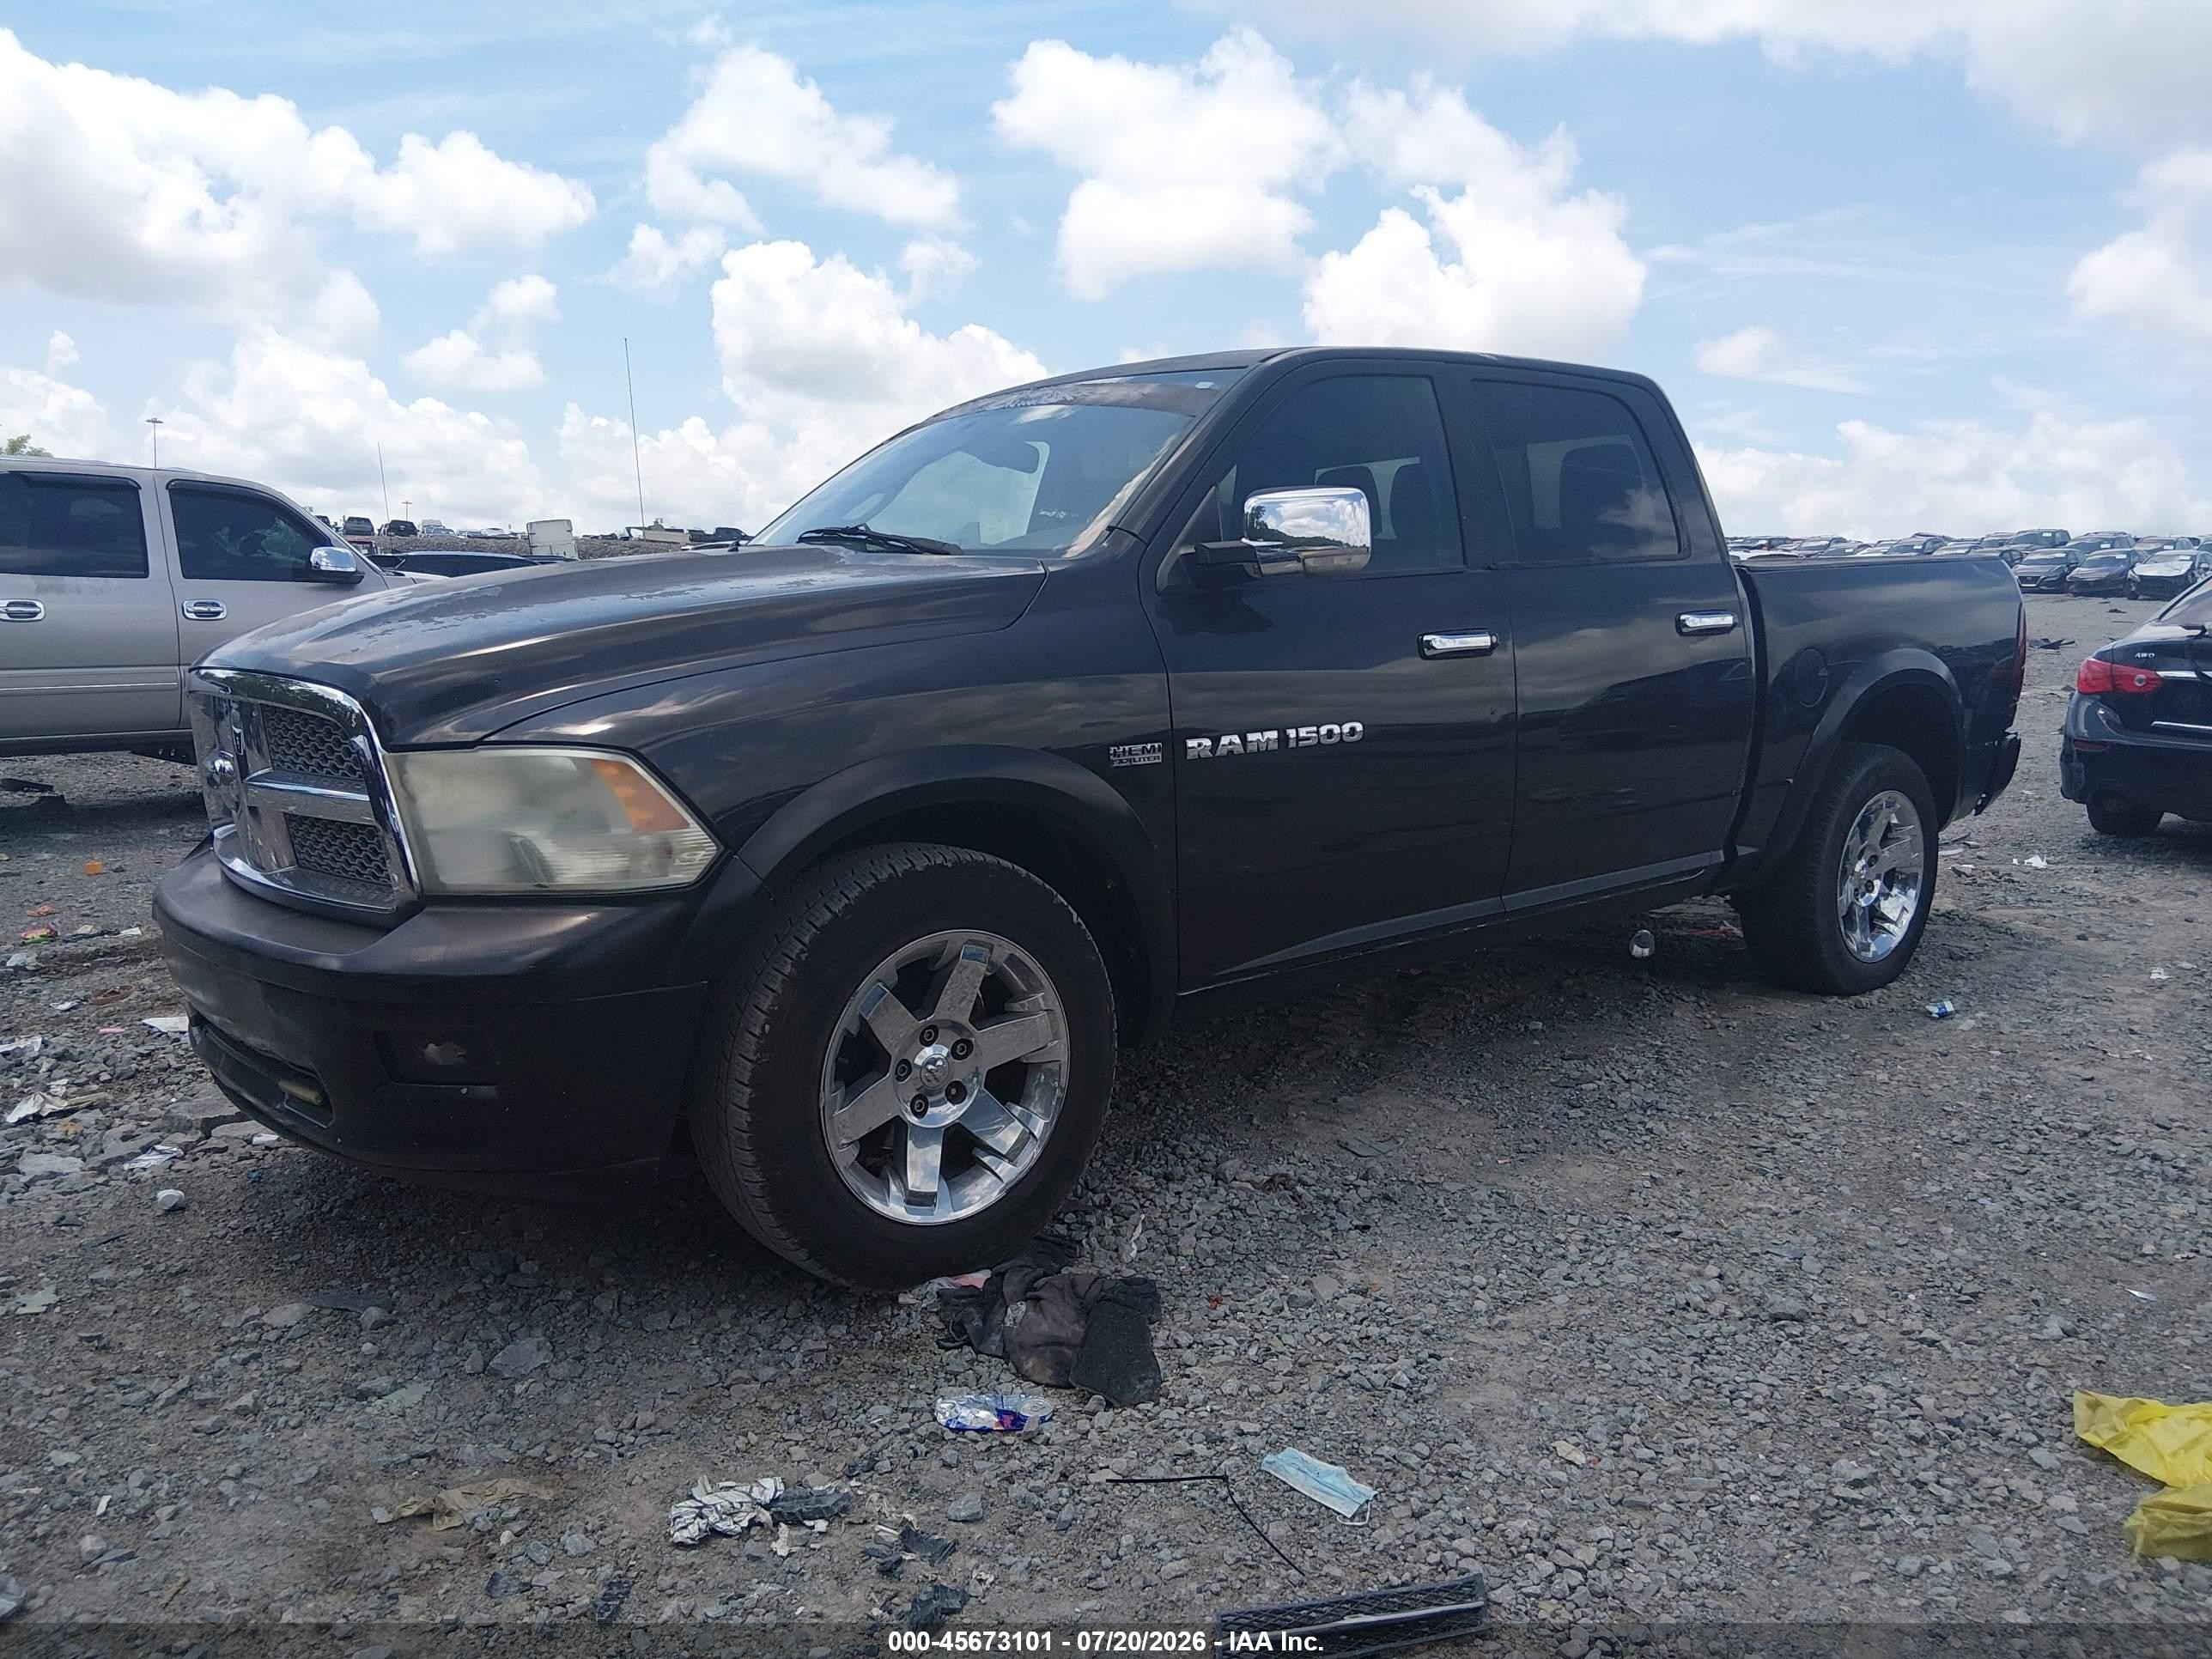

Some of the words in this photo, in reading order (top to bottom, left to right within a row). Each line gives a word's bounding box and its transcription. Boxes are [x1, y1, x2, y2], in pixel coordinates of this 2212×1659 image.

[1186, 731, 1279, 760] RAM
[1286, 721, 1364, 748] 1500
[1110, 744, 1163, 758] HEMI
[1133, 756, 1161, 764] LITER
